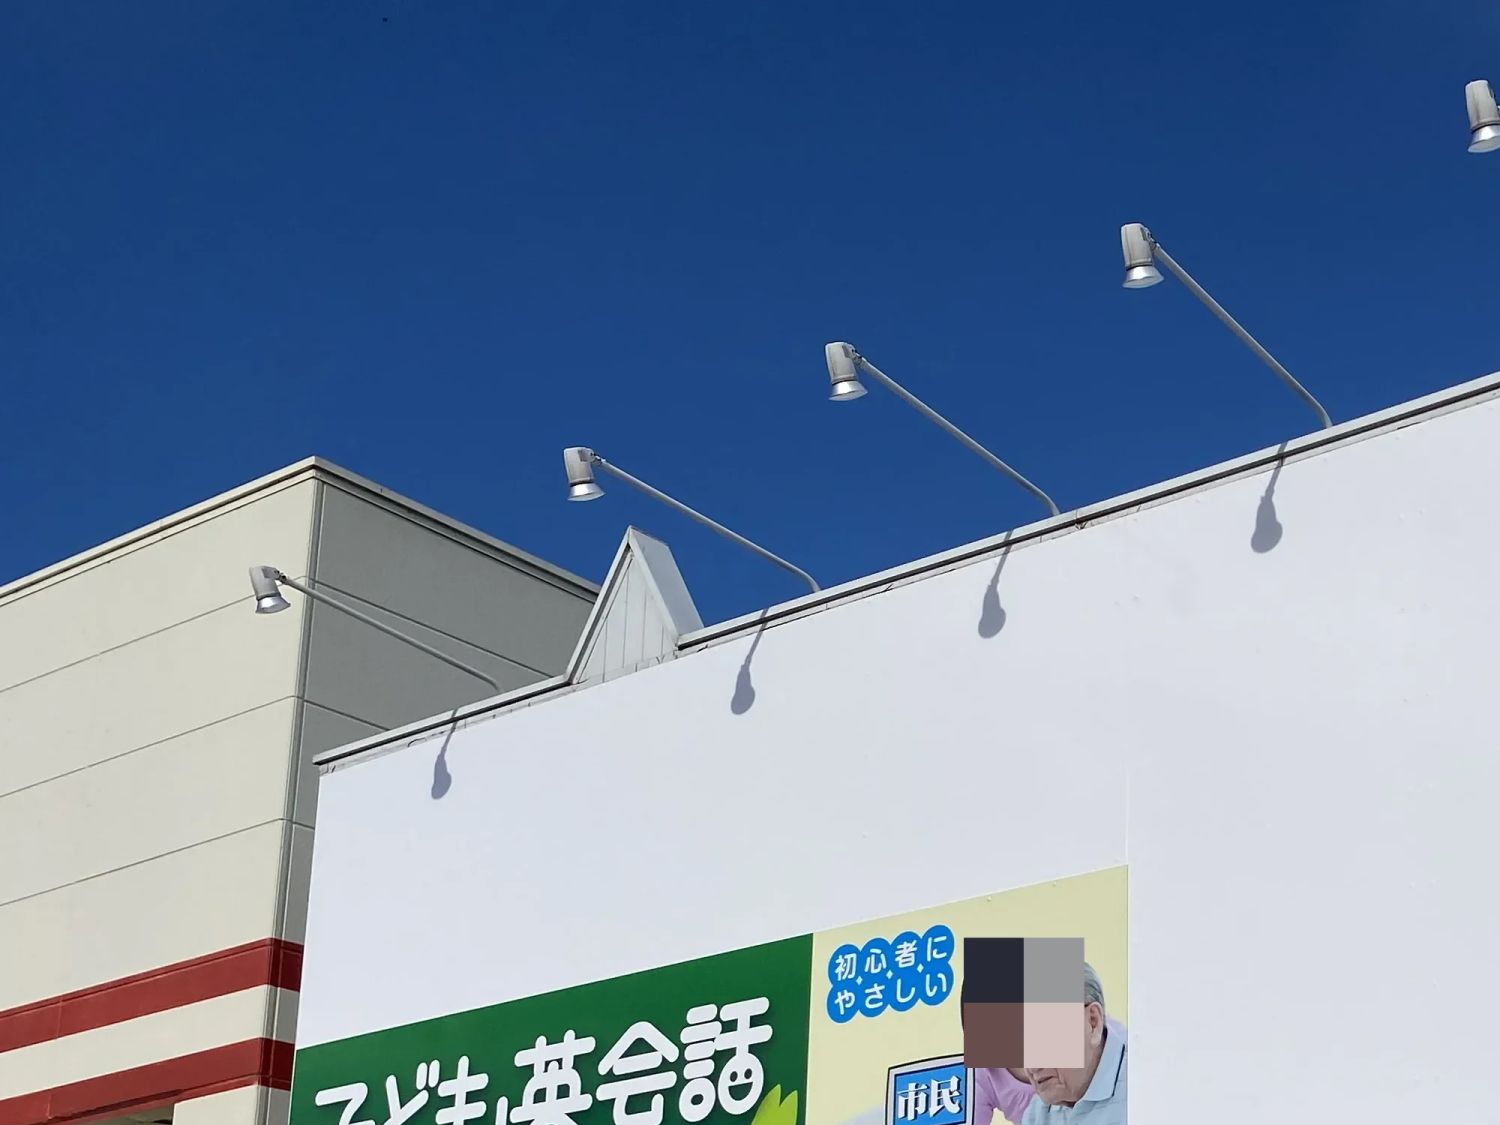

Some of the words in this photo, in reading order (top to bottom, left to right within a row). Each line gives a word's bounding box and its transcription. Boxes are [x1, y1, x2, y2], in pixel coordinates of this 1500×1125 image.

[834, 933, 949, 982] 初心者に
[834, 970, 948, 1016] やさしい
[896, 1073, 962, 1122] 市民
